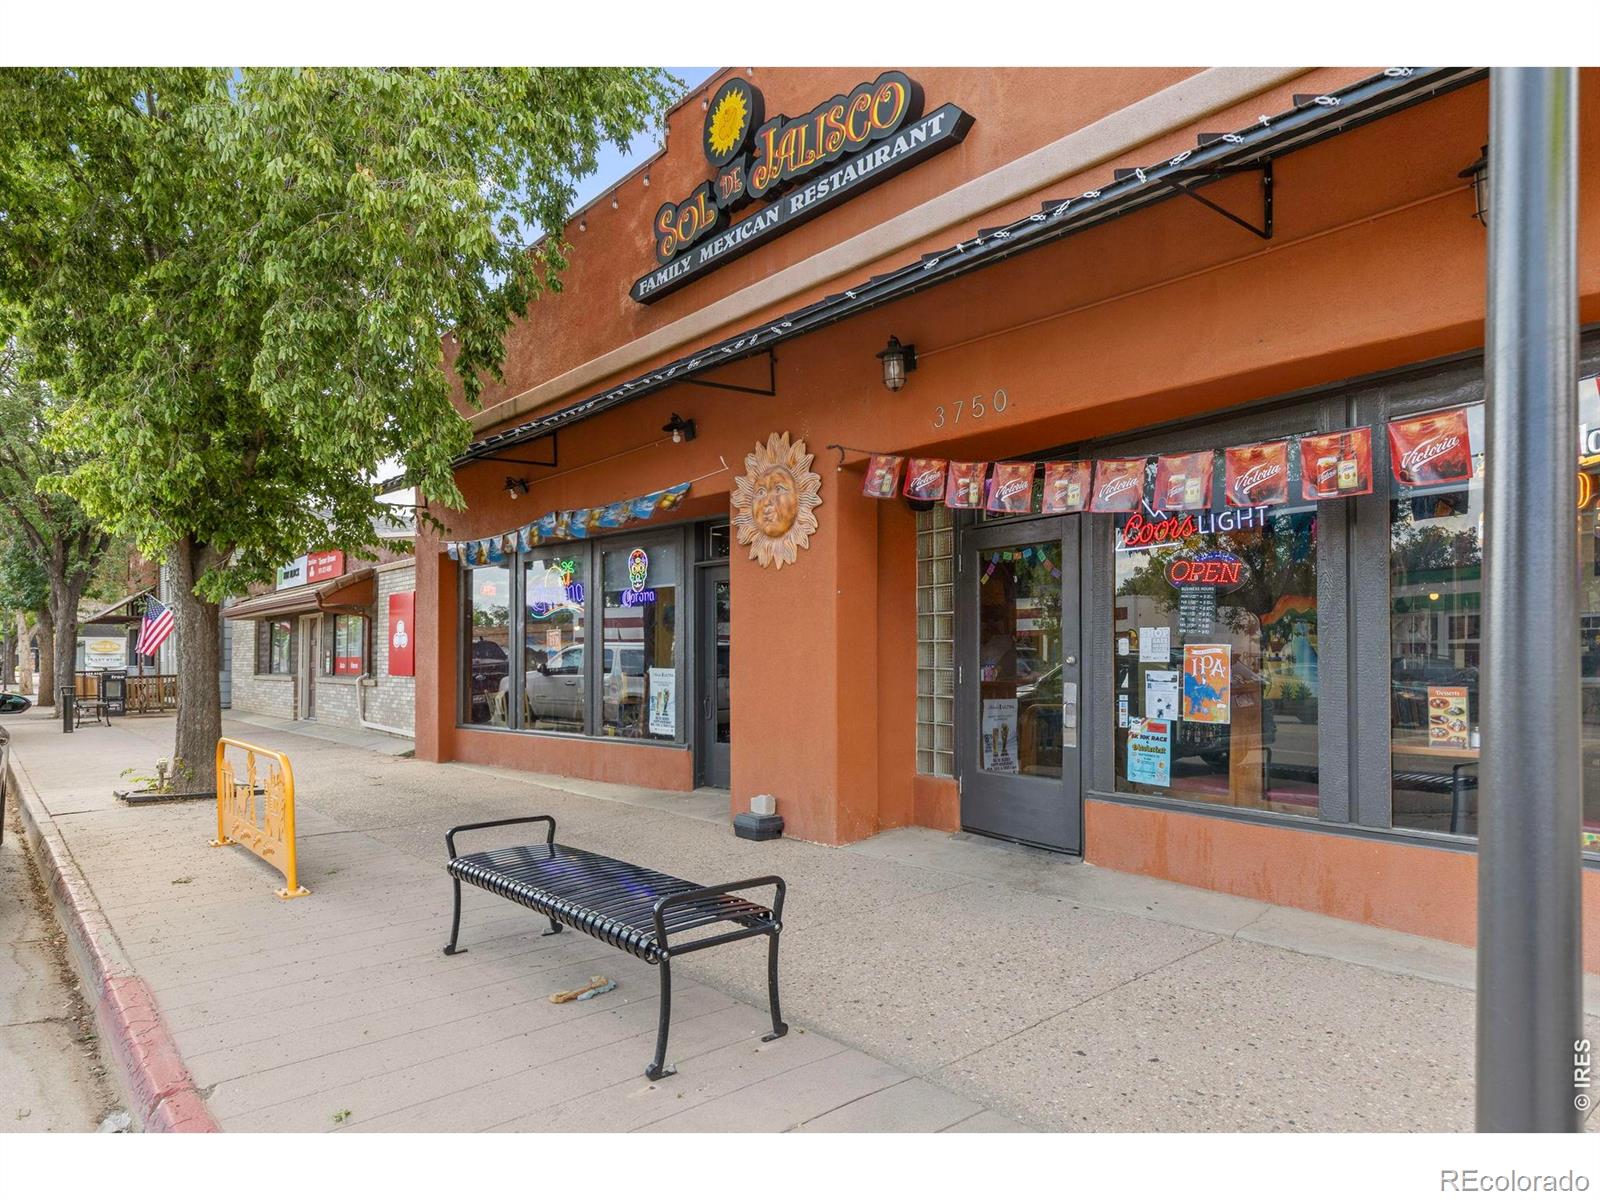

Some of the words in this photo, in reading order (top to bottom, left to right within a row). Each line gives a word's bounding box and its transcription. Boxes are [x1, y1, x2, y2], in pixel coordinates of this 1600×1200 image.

[658, 191, 716, 257] SOL
[719, 166, 743, 200] DE
[752, 81, 906, 190] JALISCO
[638, 255, 692, 297] FAMILY
[700, 206, 781, 264] MEXICAN
[789, 112, 946, 215] RESTAURANT
[933, 388, 1008, 429] 3750
[1401, 433, 1460, 473] Victoria
[995, 476, 1029, 502] Victoria
[1099, 474, 1139, 502] Victoria
[1233, 462, 1282, 495] Victoria
[1122, 513, 1197, 546] Coors
[1198, 505, 1269, 534] LIGHT
[1171, 559, 1242, 583] OPEN
[622, 588, 655, 608] Corona
[1191, 655, 1227, 679] IPA
